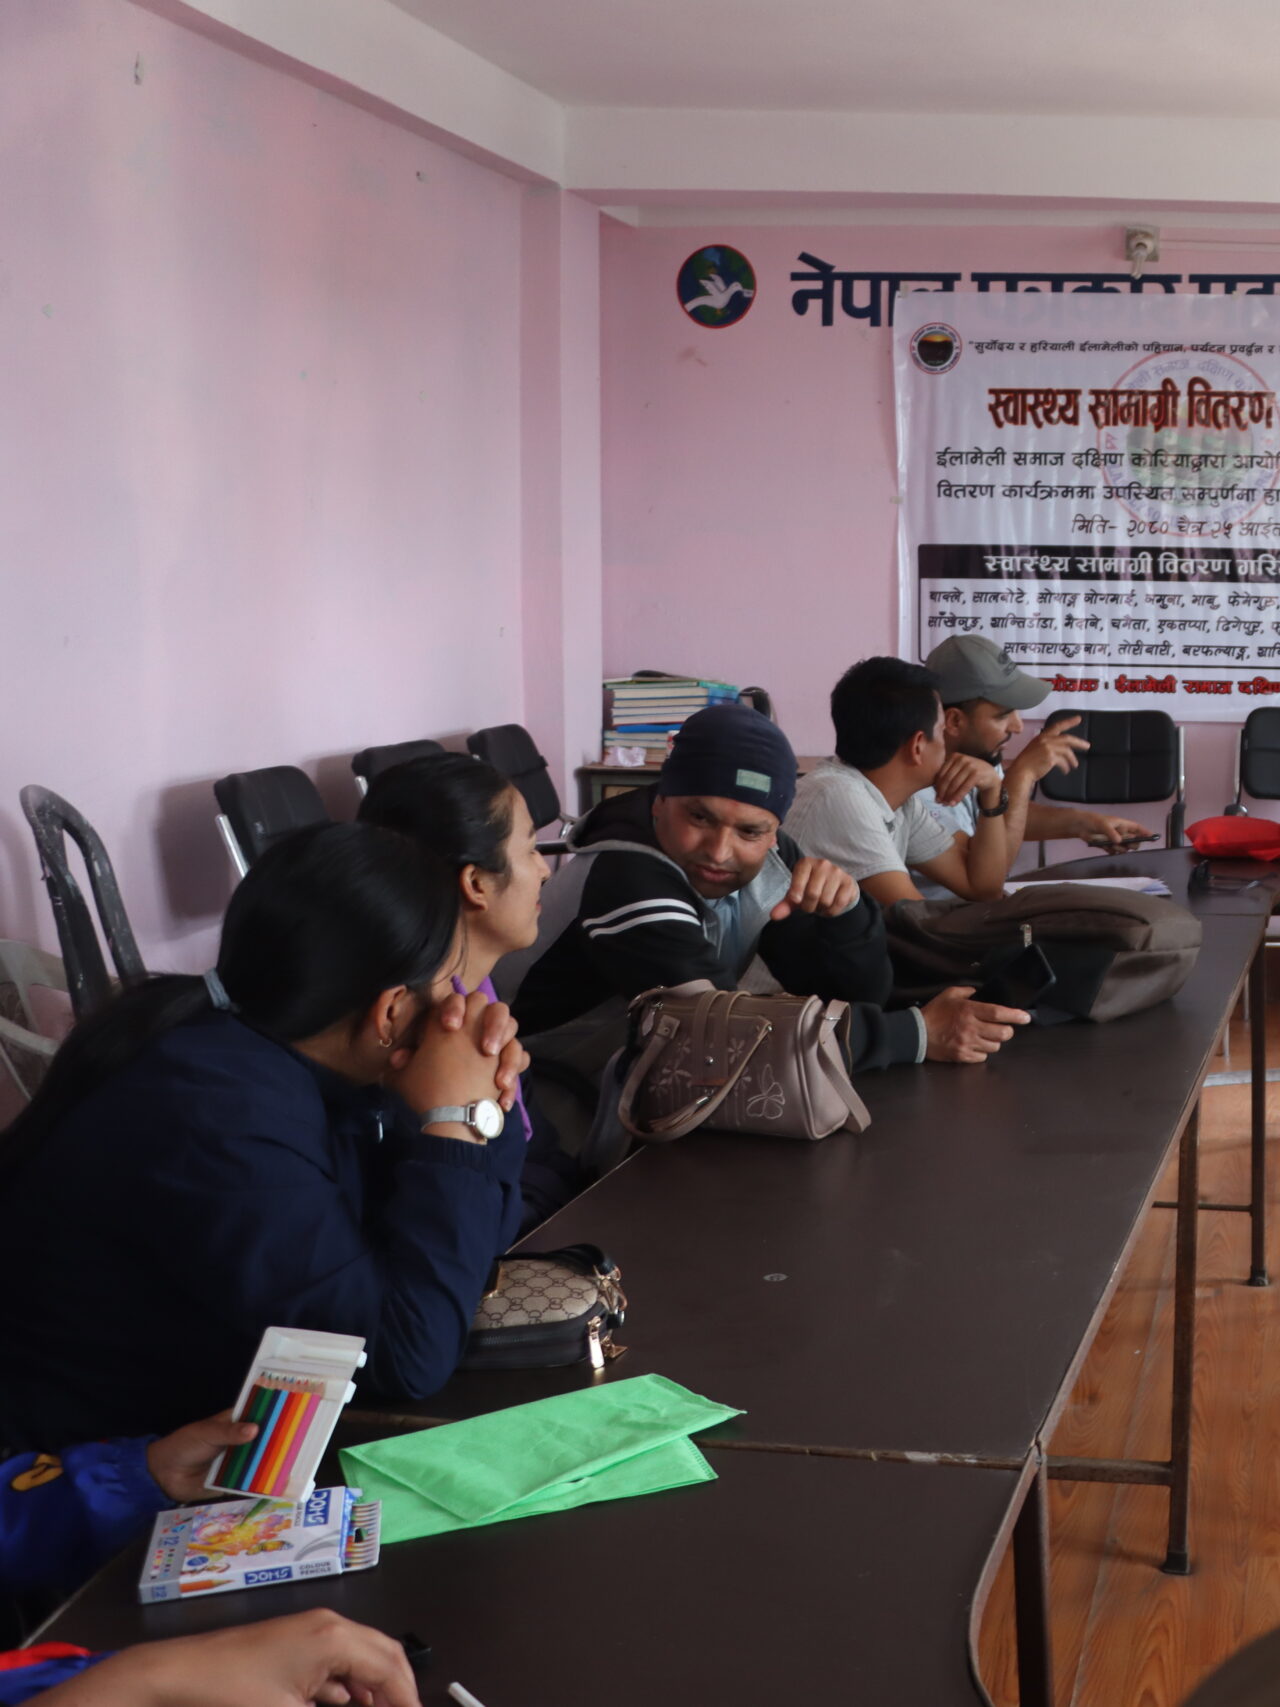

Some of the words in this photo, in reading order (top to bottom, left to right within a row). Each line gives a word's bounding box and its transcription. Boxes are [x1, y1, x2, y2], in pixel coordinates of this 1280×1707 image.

[790, 252, 961, 327] नेपा
[1019, 342, 1026, 351] र
[1030, 340, 1075, 354] हरियाली
[1267, 345, 1275, 354] र
[987, 387, 1082, 429] स्वास्थ्य
[1088, 377, 1181, 432] सामाग्री
[1186, 376, 1276, 432] वितरण
[936, 446, 1007, 467] ईलामेली
[1013, 451, 1065, 467] समाज
[1072, 447, 1125, 470] दक्षिण
[937, 480, 996, 499] वितरण
[1001, 480, 1097, 501] कार्यक्रममा
[1102, 481, 1176, 501] उपस्थित
[1126, 518, 1169, 538] २०८०
[1177, 515, 1205, 537] चैत्र
[983, 554, 1071, 574] स्वास्थ्य
[1075, 551, 1153, 576] सामाग्री
[1158, 552, 1232, 576] वितरण
[1182, 679, 1234, 695] समाज
[247, 1567, 291, 1584] DOMS
